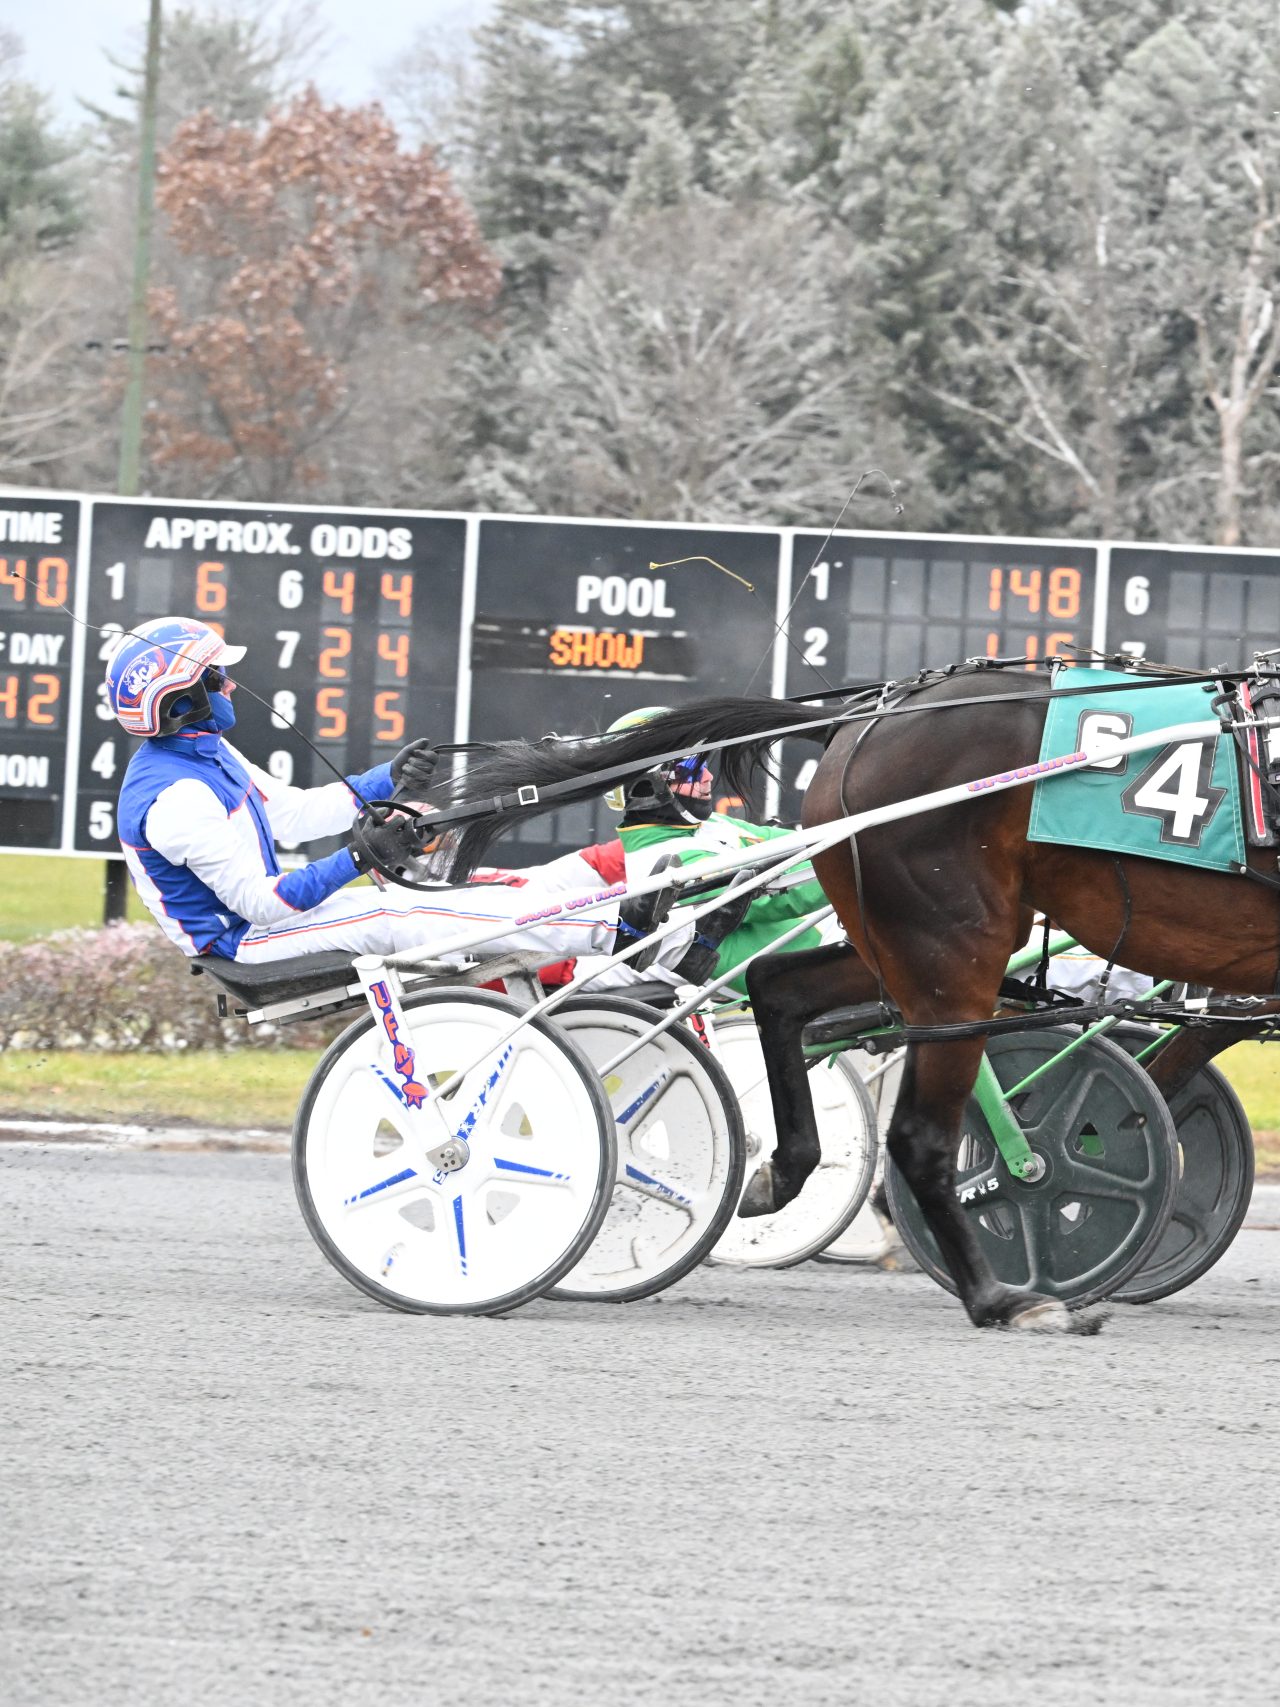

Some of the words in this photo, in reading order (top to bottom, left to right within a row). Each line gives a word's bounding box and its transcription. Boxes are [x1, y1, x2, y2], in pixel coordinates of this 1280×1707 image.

[145, 517, 301, 555] APPROX.
[310, 524, 413, 560] ODDS
[106, 562, 125, 599] 1
[196, 562, 227, 611] 6
[278, 570, 303, 609] 6
[576, 575, 675, 617] POOL
[811, 562, 829, 600] 1
[989, 568, 1081, 618] 148
[1125, 576, 1150, 616] 6
[10, 632, 65, 666] DAY
[276, 631, 300, 669] 7
[550, 631, 644, 669] SHOW
[803, 627, 829, 666] 2
[270, 690, 297, 729] 8
[92, 741, 115, 779] 4
[269, 750, 294, 786] 9
[1135, 742, 1209, 838] 4
[89, 802, 113, 839] 5
